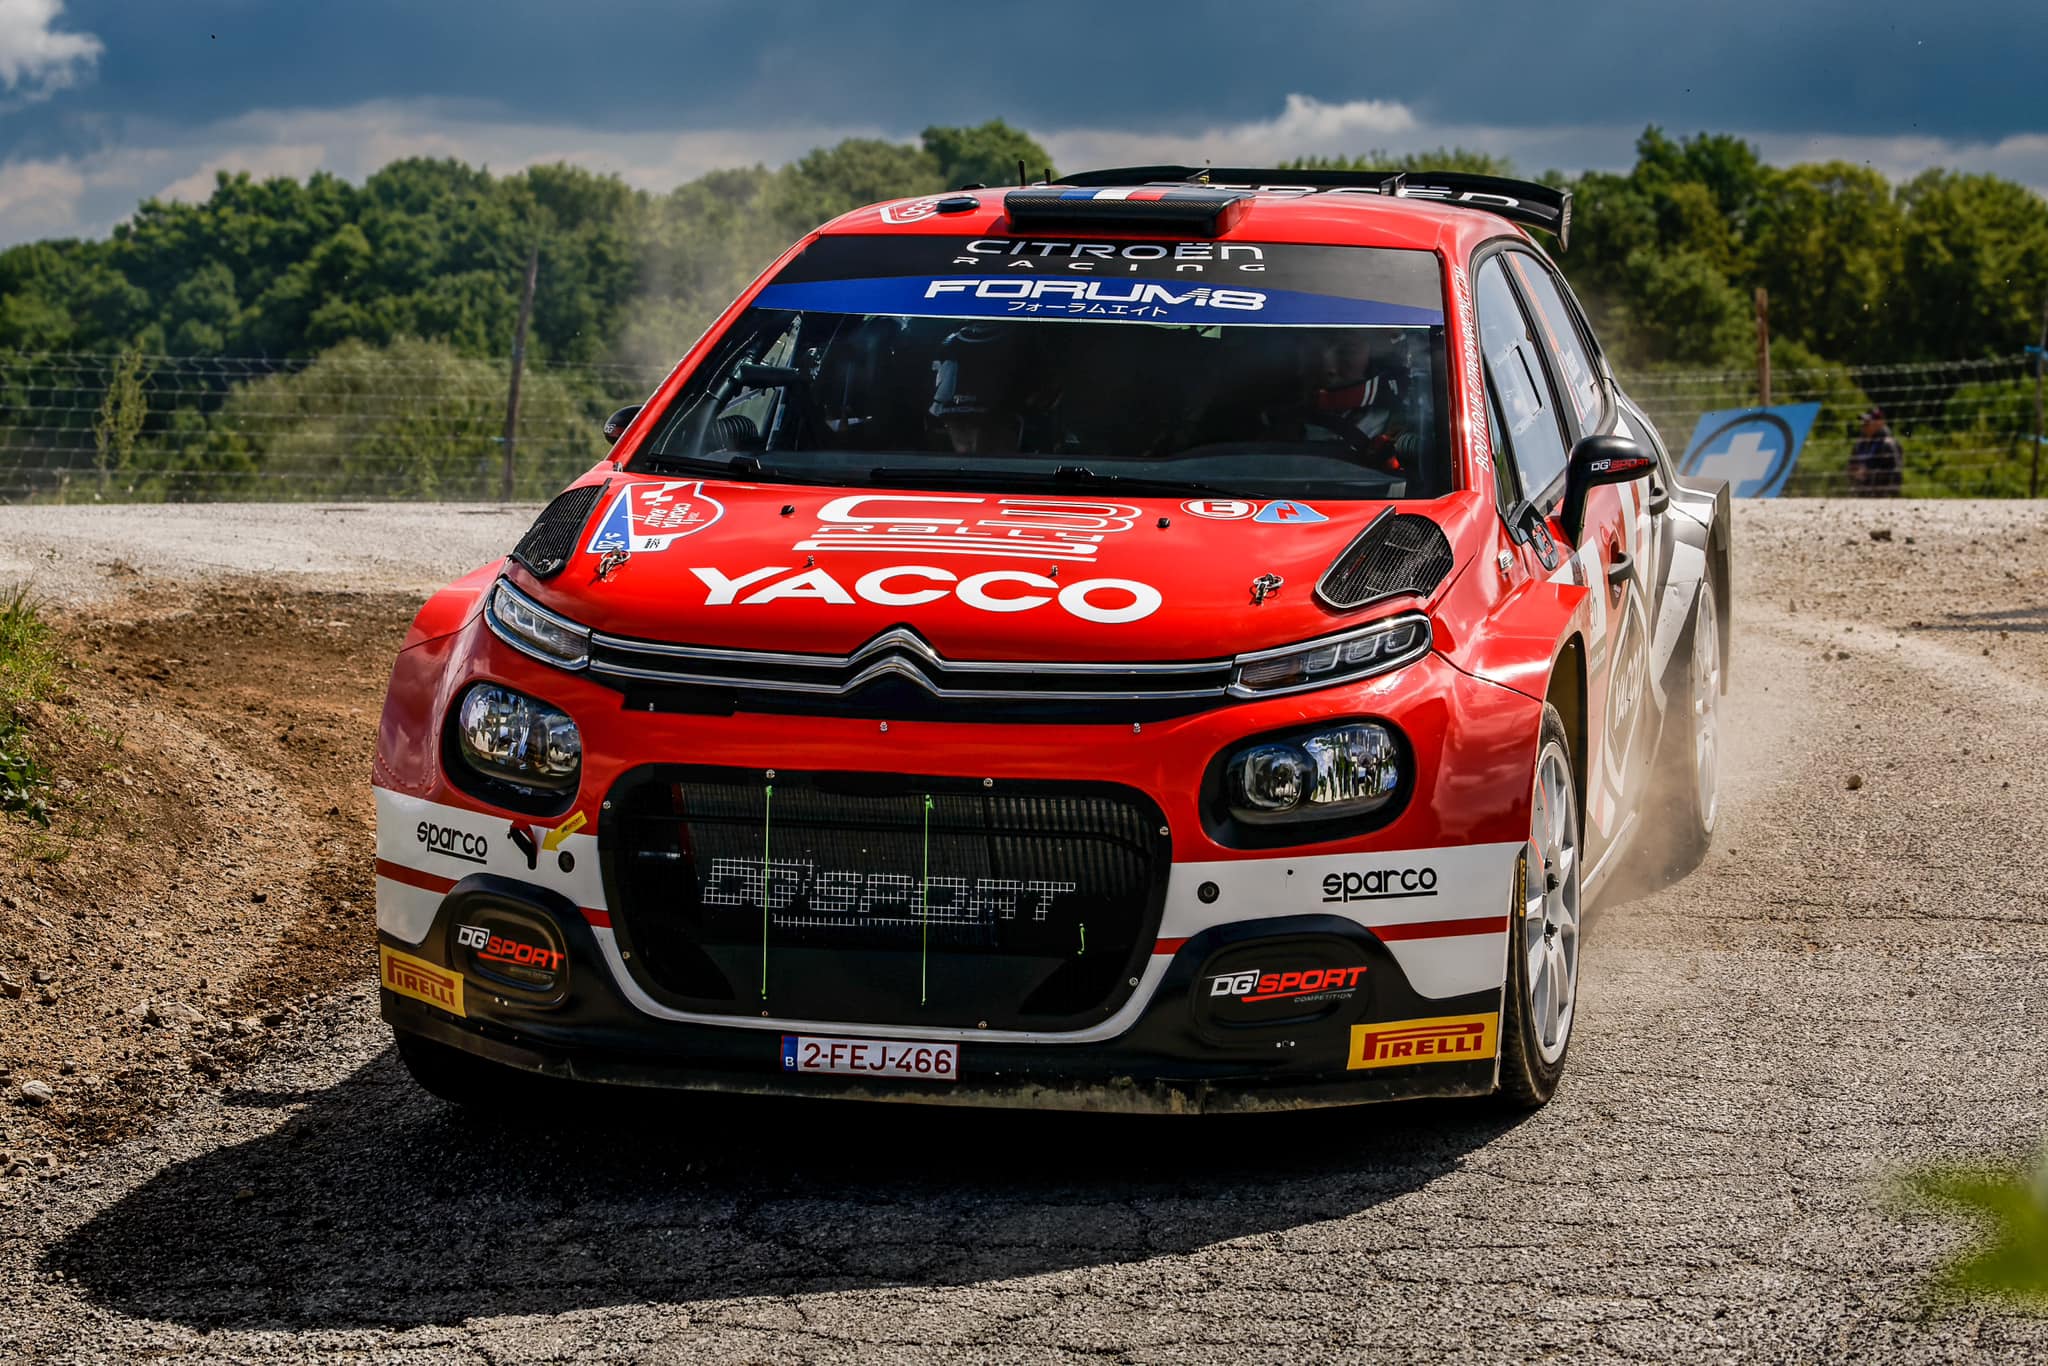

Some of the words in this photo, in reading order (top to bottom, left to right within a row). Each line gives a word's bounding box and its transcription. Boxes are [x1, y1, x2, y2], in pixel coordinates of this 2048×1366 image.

[923, 279, 1266, 311] FORUM8
[1007, 300, 1168, 318] フォーラムエイト
[643, 507, 669, 528] RALLY
[661, 502, 692, 529] CROATIA
[816, 494, 1143, 534] C3
[1203, 502, 1235, 514] E
[688, 563, 1163, 624] YACCO
[416, 821, 488, 858] sparco
[1322, 867, 1438, 902] sparco
[387, 955, 456, 1009] PIRELLI
[1293, 992, 1353, 1004] COMPETITION
[785, 1056, 795, 1067] B
[803, 1042, 953, 1075] 2-FEJ-466
[1361, 1022, 1486, 1062] PIRELLI
